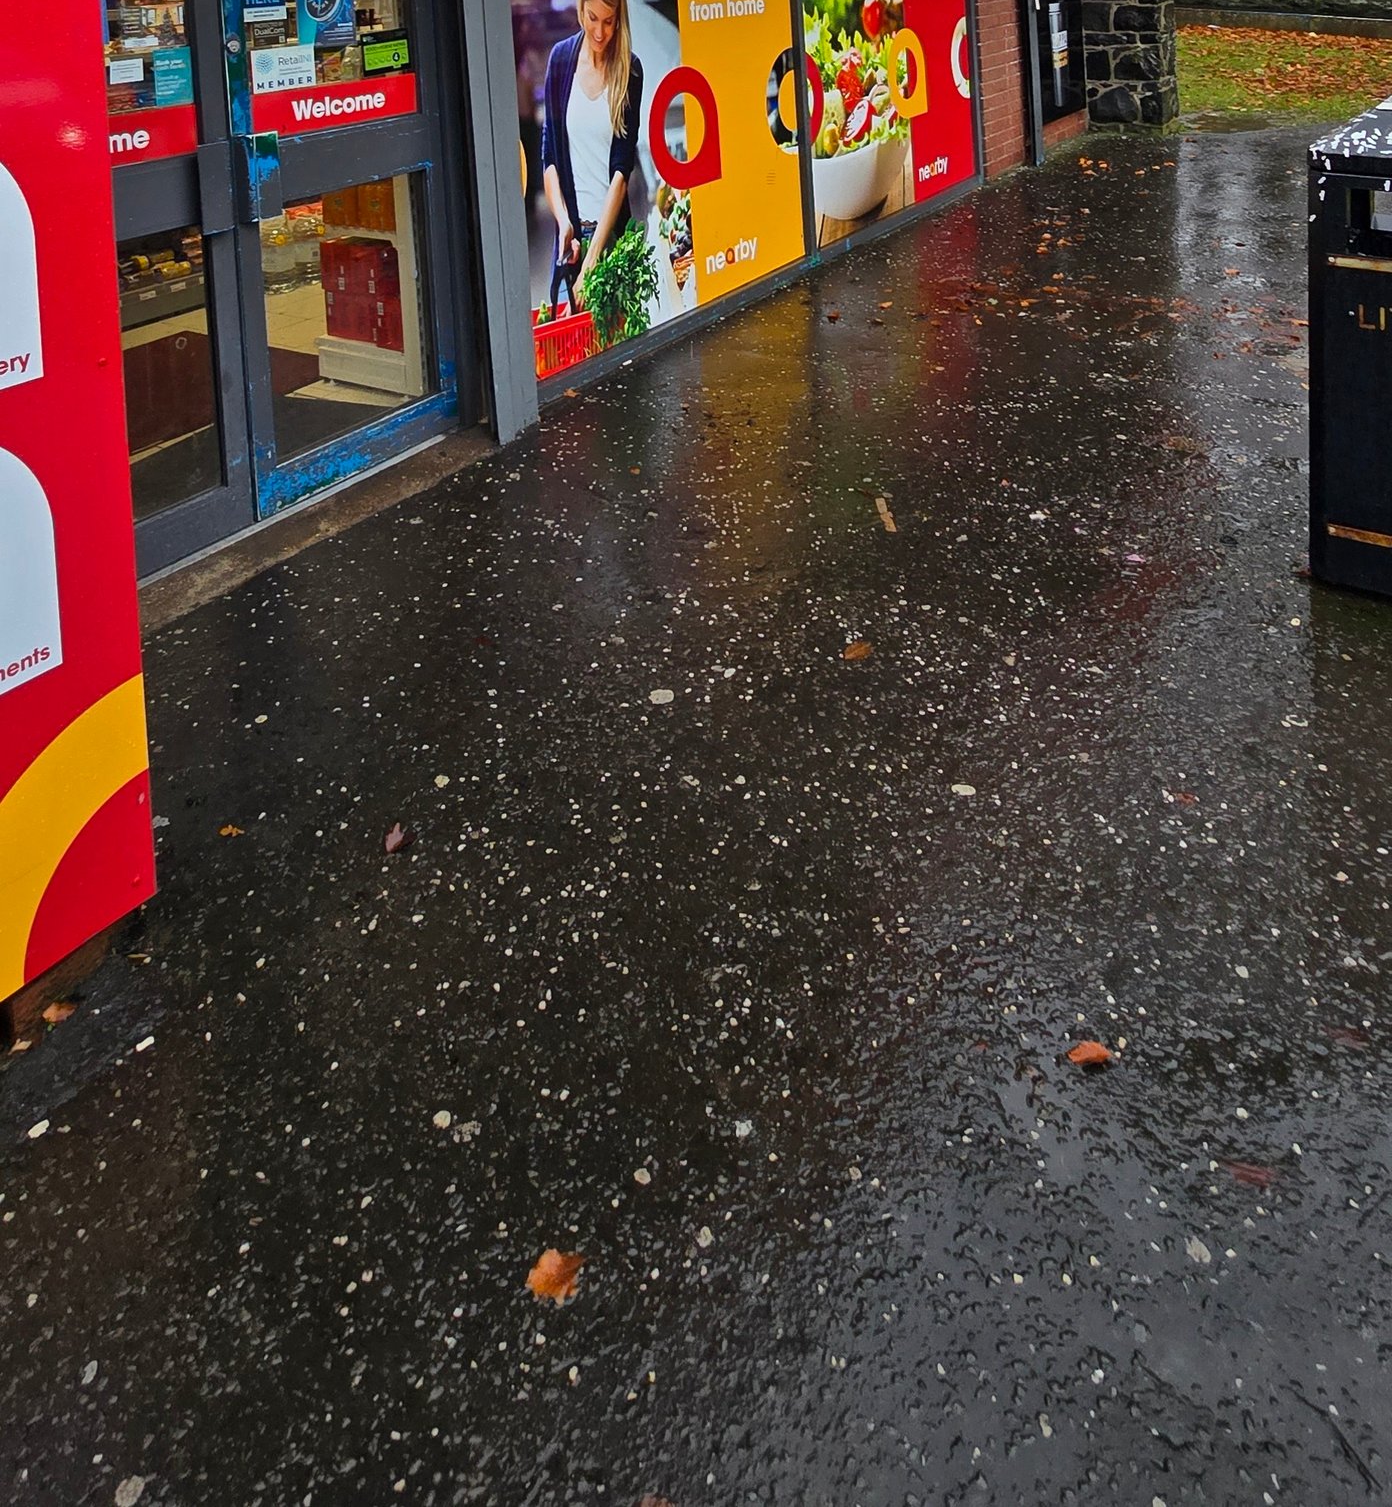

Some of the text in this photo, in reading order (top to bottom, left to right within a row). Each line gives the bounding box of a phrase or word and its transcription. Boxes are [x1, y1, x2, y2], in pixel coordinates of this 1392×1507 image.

[690, 0, 723, 22] from
[254, 27, 285, 36] DualCom
[256, 76, 313, 90] MEMBER
[292, 93, 385, 121] Welcome
[919, 157, 948, 182] nearby
[706, 237, 757, 275] nearby
